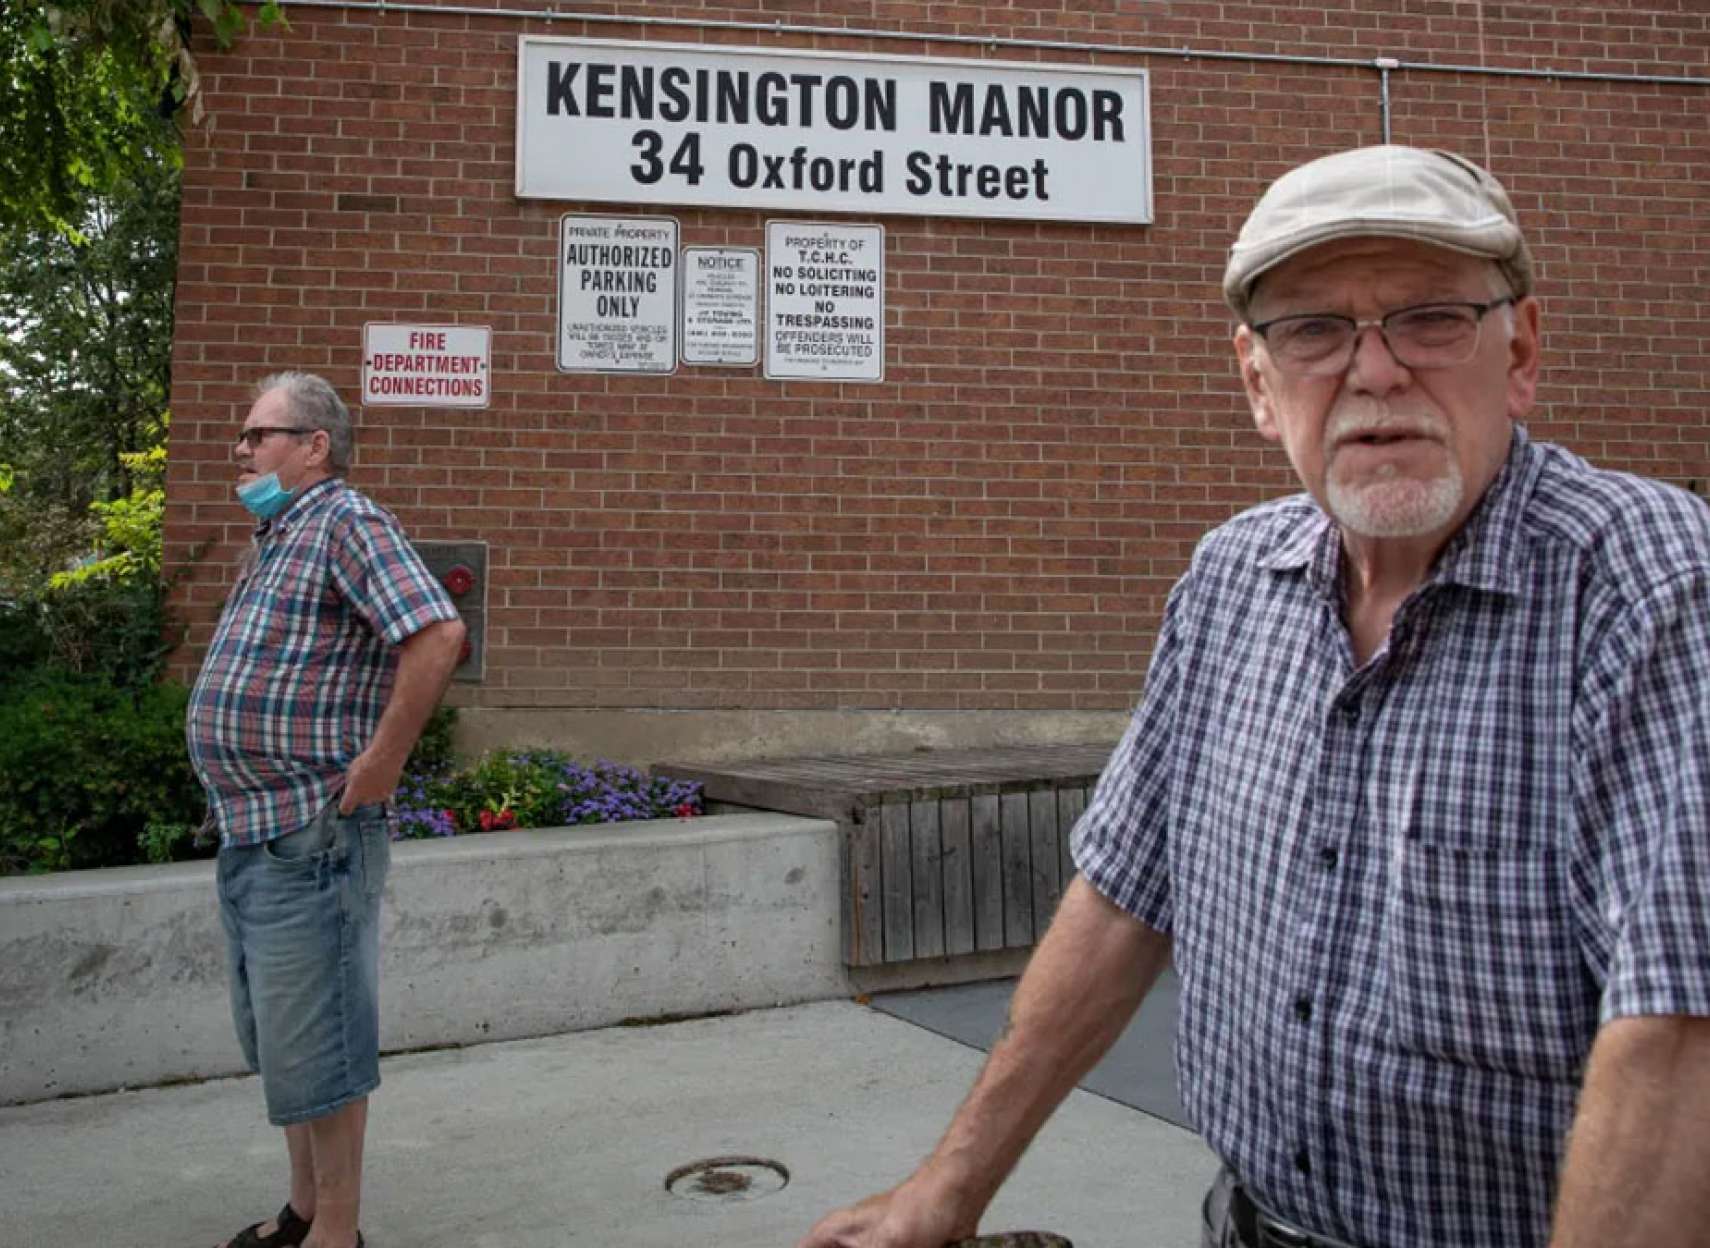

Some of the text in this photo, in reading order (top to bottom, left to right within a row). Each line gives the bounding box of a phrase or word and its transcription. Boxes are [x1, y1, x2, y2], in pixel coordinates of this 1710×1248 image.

[546, 61, 1125, 142] KENSINGTON MANOR
[630, 130, 1049, 200] 34 Oxford Street
[568, 227, 671, 240] PRIVATE PROPERTY
[785, 236, 865, 251] PROPERTY OF
[566, 244, 672, 268] AUTHORIZED
[698, 257, 744, 269] NOTICE
[798, 250, 854, 265] T.C.H.C.
[581, 270, 657, 292] PARKING
[773, 266, 877, 282] NO SOLICITING
[775, 283, 875, 298] NO LOITERING
[596, 295, 640, 317] ONLY
[814, 300, 835, 313] NO
[776, 314, 874, 329] TRESPASSING
[409, 332, 446, 351] FIRE
[775, 330, 874, 345] OFFENDERS WILL
[776, 343, 873, 357] BE PROSECUTED
[374, 353, 481, 374] DEPARTMENT
[369, 376, 483, 396] CONNECTIONS
